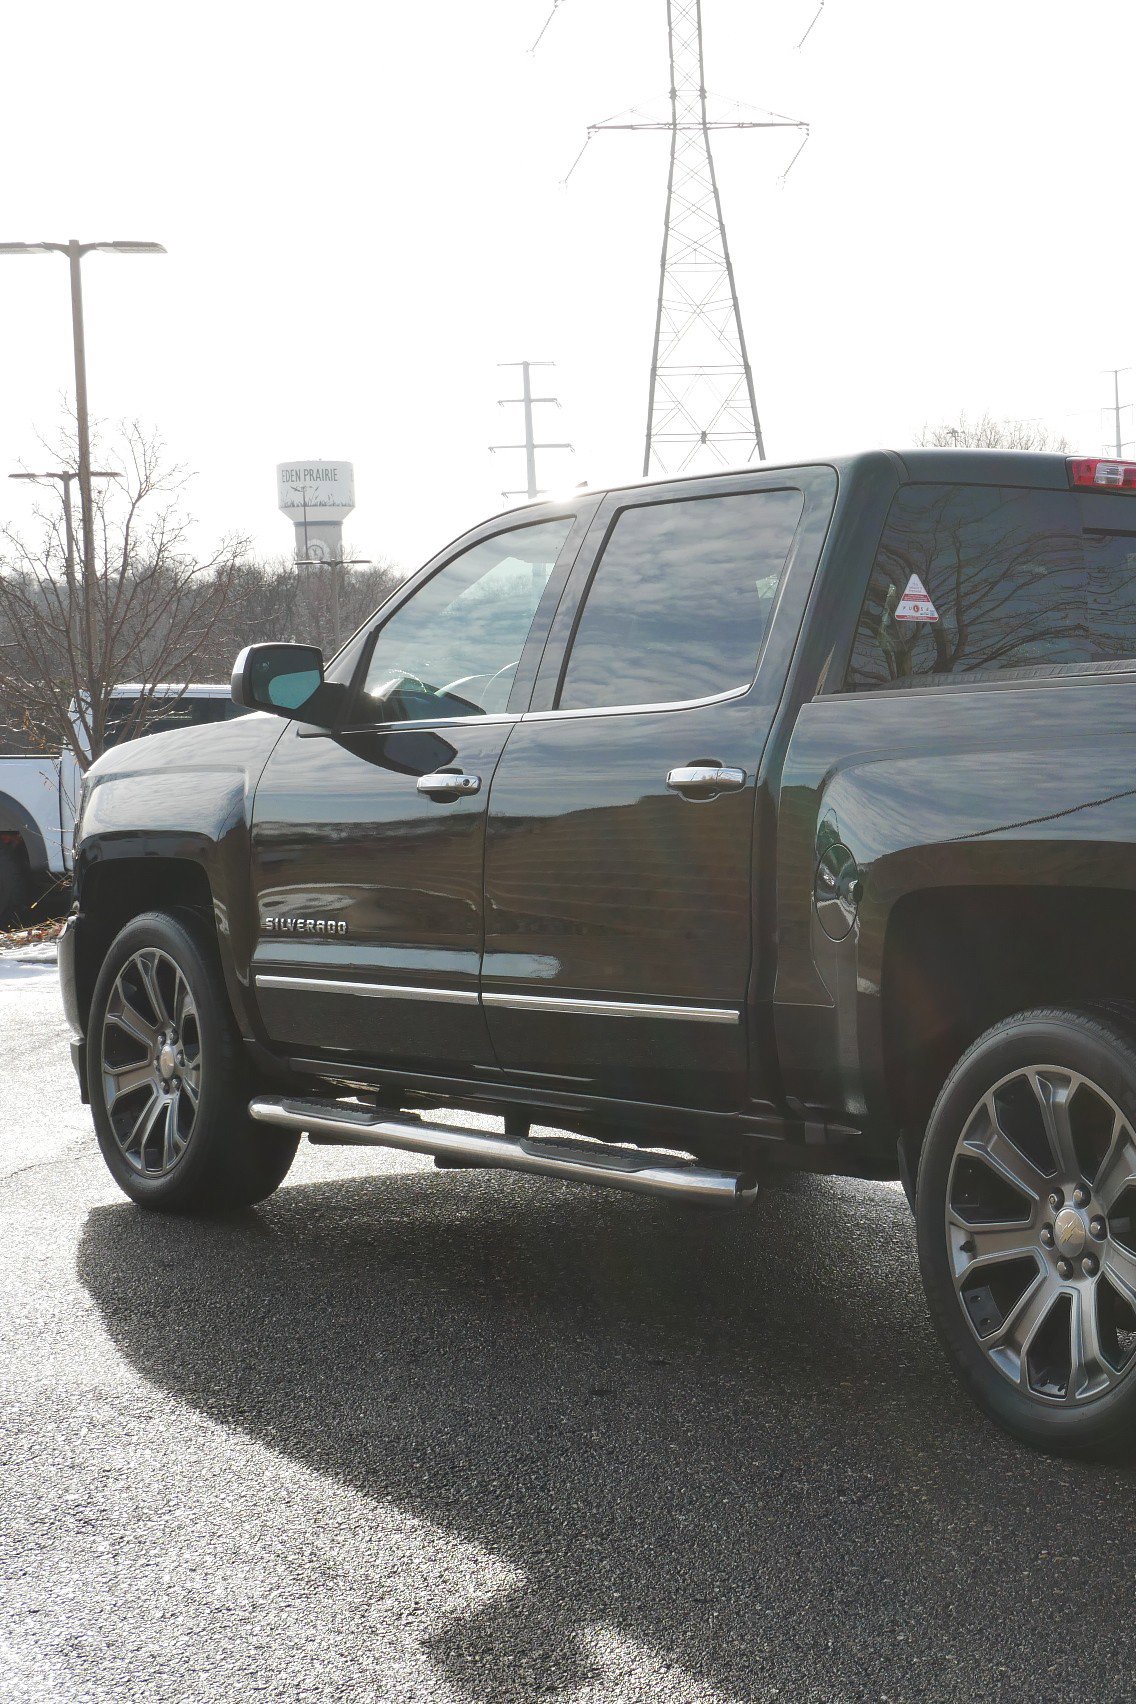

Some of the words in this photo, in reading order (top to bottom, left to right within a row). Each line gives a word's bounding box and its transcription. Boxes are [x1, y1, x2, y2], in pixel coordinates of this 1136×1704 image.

[281, 469, 301, 483] EDEN
[303, 468, 338, 482] PRAIRIE
[265, 918, 346, 935] SILVERADO
